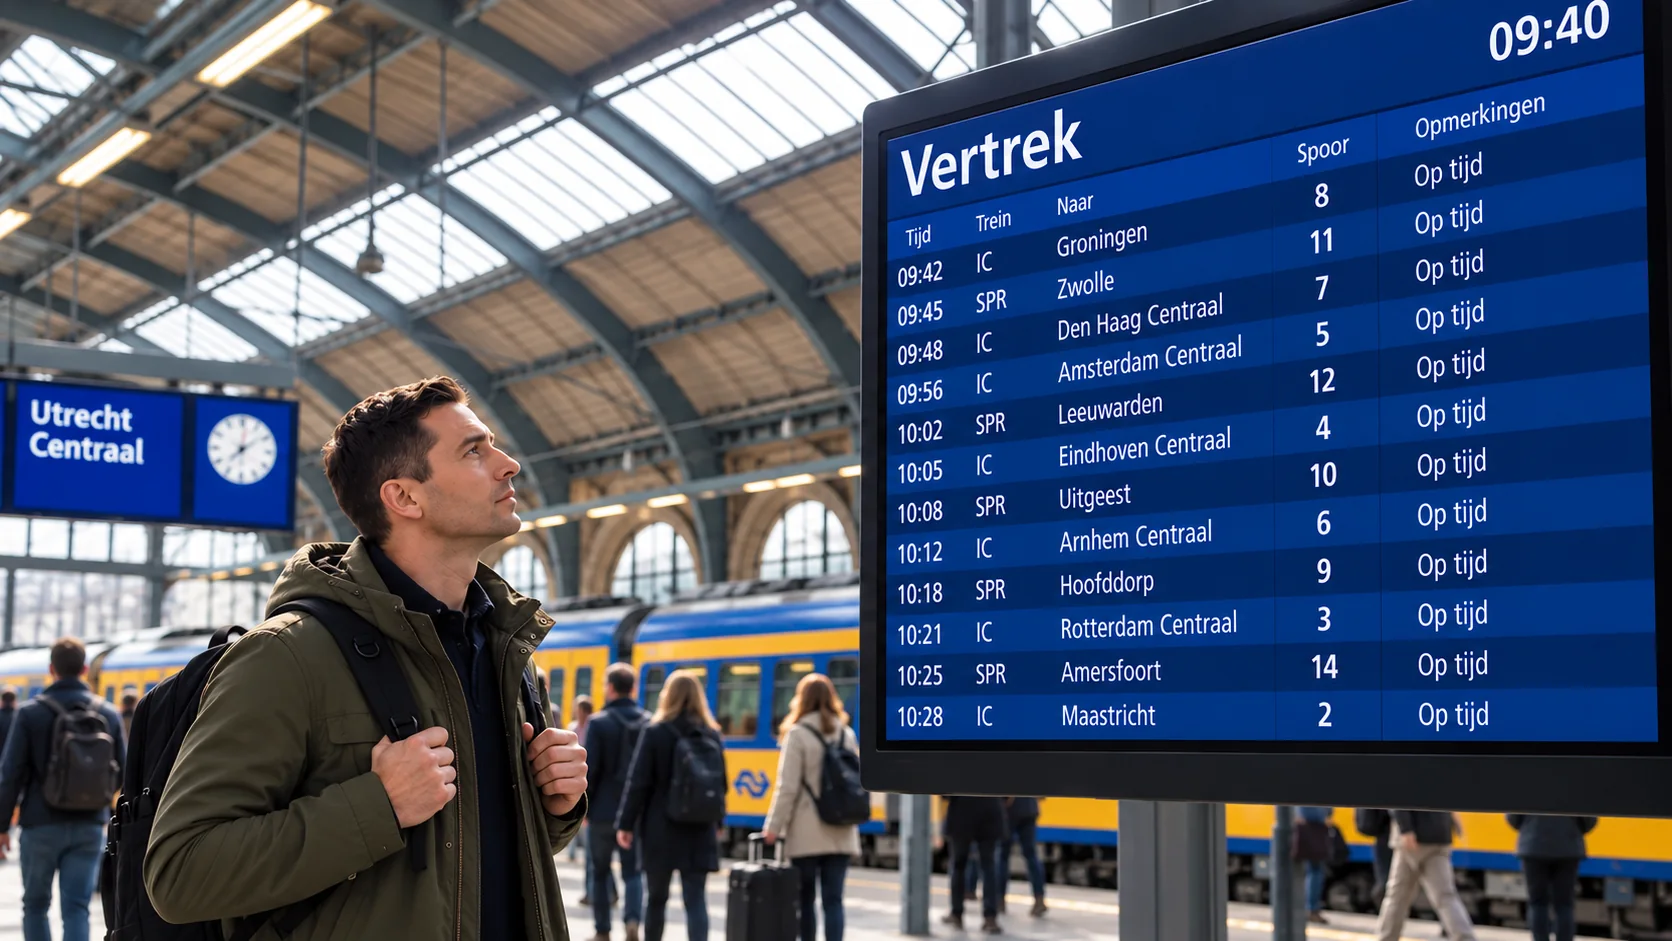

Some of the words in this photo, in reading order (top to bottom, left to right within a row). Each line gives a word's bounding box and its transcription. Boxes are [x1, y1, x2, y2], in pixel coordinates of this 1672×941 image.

[1489, 0, 1610, 62] 09:40
[1415, 96, 1545, 141] Opmerkingen
[900, 108, 1083, 197] Vertrek
[1297, 137, 1350, 167] Spoor
[1414, 163, 1443, 190] Op
[1448, 151, 1483, 184] tijd
[1057, 194, 1094, 216] Naar
[1314, 182, 1330, 208] 8
[975, 209, 1012, 232] Trein
[1415, 211, 1444, 238] Op
[1449, 199, 1483, 232] tijd
[905, 224, 931, 249] Tijd
[1057, 225, 1148, 257] Groningen
[1310, 227, 1333, 254] 11
[897, 260, 943, 288] 09:42
[977, 250, 993, 274] IC
[1415, 258, 1444, 286] Op
[1450, 247, 1484, 281] tijd
[1057, 269, 1115, 300] Zwolle
[1315, 274, 1329, 301] 7
[897, 299, 943, 327] 09:45
[976, 288, 1007, 314] SPR
[1058, 319, 1091, 341] Den
[1097, 312, 1141, 335] Haag
[1147, 291, 1223, 326] Centraal
[1415, 307, 1445, 335] Op
[1450, 297, 1485, 331] tijd
[976, 331, 993, 354] IC
[1316, 320, 1330, 347] 5
[897, 339, 944, 366] 09:48
[1057, 350, 1159, 383] Amsterdam
[1165, 333, 1242, 367] Centraal
[1416, 355, 1446, 383] Op
[1451, 347, 1485, 380] tijd
[897, 379, 943, 405] 09:56
[976, 372, 993, 395] IC
[1309, 367, 1336, 394] 12
[29, 398, 132, 432] Utrecht
[1058, 392, 1163, 425] Leeuwarden
[1416, 404, 1446, 432] Op
[1452, 396, 1486, 429] tijd
[898, 419, 943, 445] 10:02
[975, 412, 1006, 435] SPR
[1315, 415, 1331, 440] 4
[28, 431, 144, 465] Centraal
[1059, 440, 1149, 467] Eindhoven
[1155, 425, 1231, 456] Centraal
[897, 459, 943, 484] 10:05
[976, 453, 993, 476] IC
[1310, 461, 1337, 488] 10
[1417, 453, 1446, 482] Op
[1452, 446, 1487, 479] tijd
[897, 499, 943, 524] 10:08
[975, 494, 1006, 518] SPR
[1059, 484, 1132, 513] Uitgeest
[1316, 509, 1331, 536] 6
[1417, 502, 1447, 531] Op
[1452, 497, 1487, 530] tijd
[976, 536, 993, 559] IC
[1059, 527, 1129, 553] Arnhem
[1135, 518, 1212, 547] Centraal
[897, 540, 943, 564] 10:12
[1417, 553, 1447, 582] Op
[1453, 548, 1487, 581] tijd
[1060, 570, 1154, 597] Hoofddorp
[1316, 557, 1332, 584] 9
[898, 581, 943, 605] 10:18
[975, 578, 1006, 601] SPR
[1061, 614, 1154, 640] Rotterdam
[1160, 609, 1237, 636] Centraal
[1317, 606, 1331, 632] 3
[1417, 602, 1447, 633] Op
[1453, 598, 1488, 631] tijd
[897, 623, 943, 646] 10:21
[976, 621, 993, 643] IC
[898, 664, 943, 686] 10:25
[975, 663, 1007, 685] SPR
[1061, 658, 1162, 683] Amersfoort
[1311, 653, 1339, 679] 14
[1418, 652, 1448, 682] Op
[1453, 649, 1488, 682] tijd
[897, 705, 943, 727] 10:28
[977, 705, 993, 727] IC
[1062, 702, 1156, 726] Maastricht
[1318, 701, 1332, 727] 2
[1418, 702, 1448, 732] Op
[1454, 700, 1489, 732] tijd
